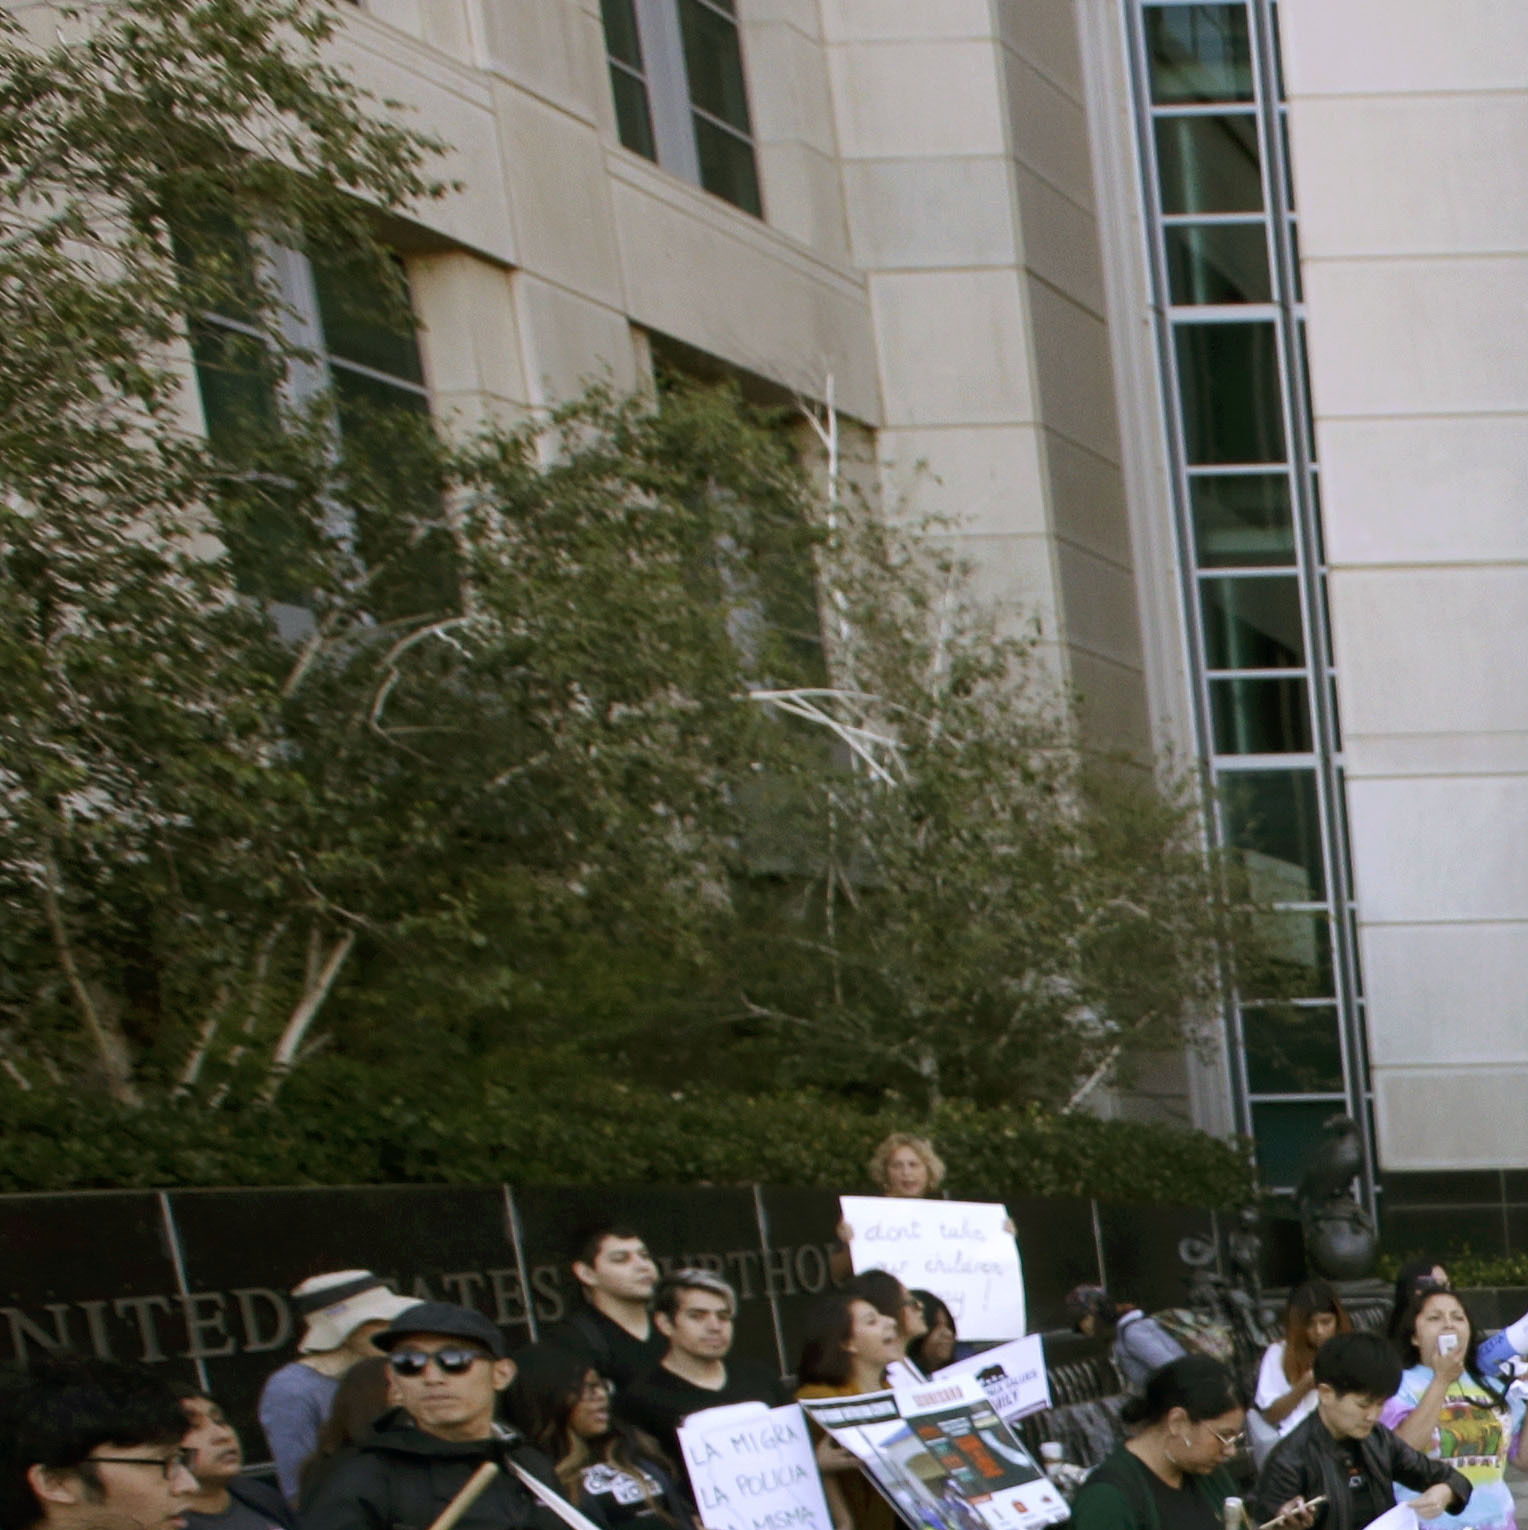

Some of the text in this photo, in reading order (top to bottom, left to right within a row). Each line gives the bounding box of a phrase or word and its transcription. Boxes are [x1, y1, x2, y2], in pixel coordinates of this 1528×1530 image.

[0, 1287, 293, 1372] NITED
[385, 1263, 567, 1324] ATES
[689, 1423, 801, 1467] LA MIGRA
[701, 1463, 811, 1510] LA POLICIA
